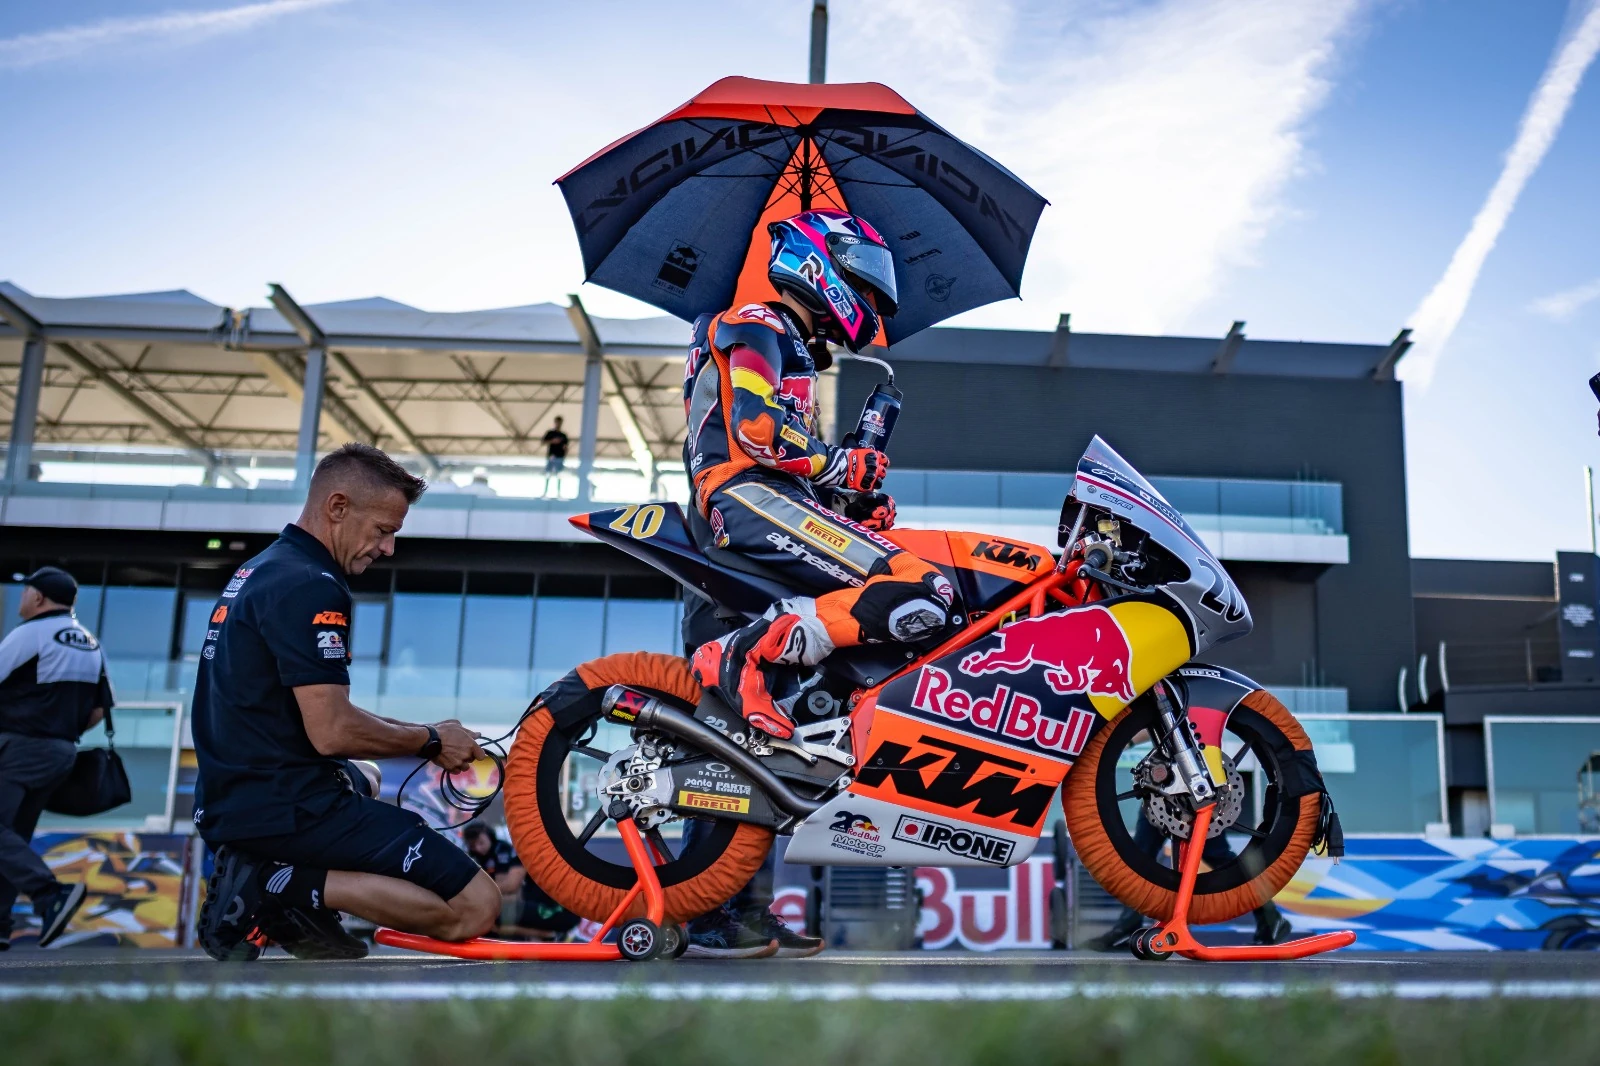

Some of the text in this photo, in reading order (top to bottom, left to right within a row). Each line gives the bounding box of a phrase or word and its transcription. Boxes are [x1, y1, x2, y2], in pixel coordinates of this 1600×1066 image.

[609, 504, 665, 539] 20
[804, 520, 846, 548] PIRELLI
[765, 532, 865, 588] alpinestars
[971, 539, 1042, 571] KTM
[312, 611, 347, 626] KTM
[698, 770, 737, 779] OAKLEY
[716, 781, 752, 791] PARTS
[854, 735, 1059, 828] KTM
[686, 793, 741, 812] PIRELLI
[831, 842, 866, 855] ROOKIES
[832, 834, 886, 853] MotoGP
[920, 824, 1012, 864] IPONE
